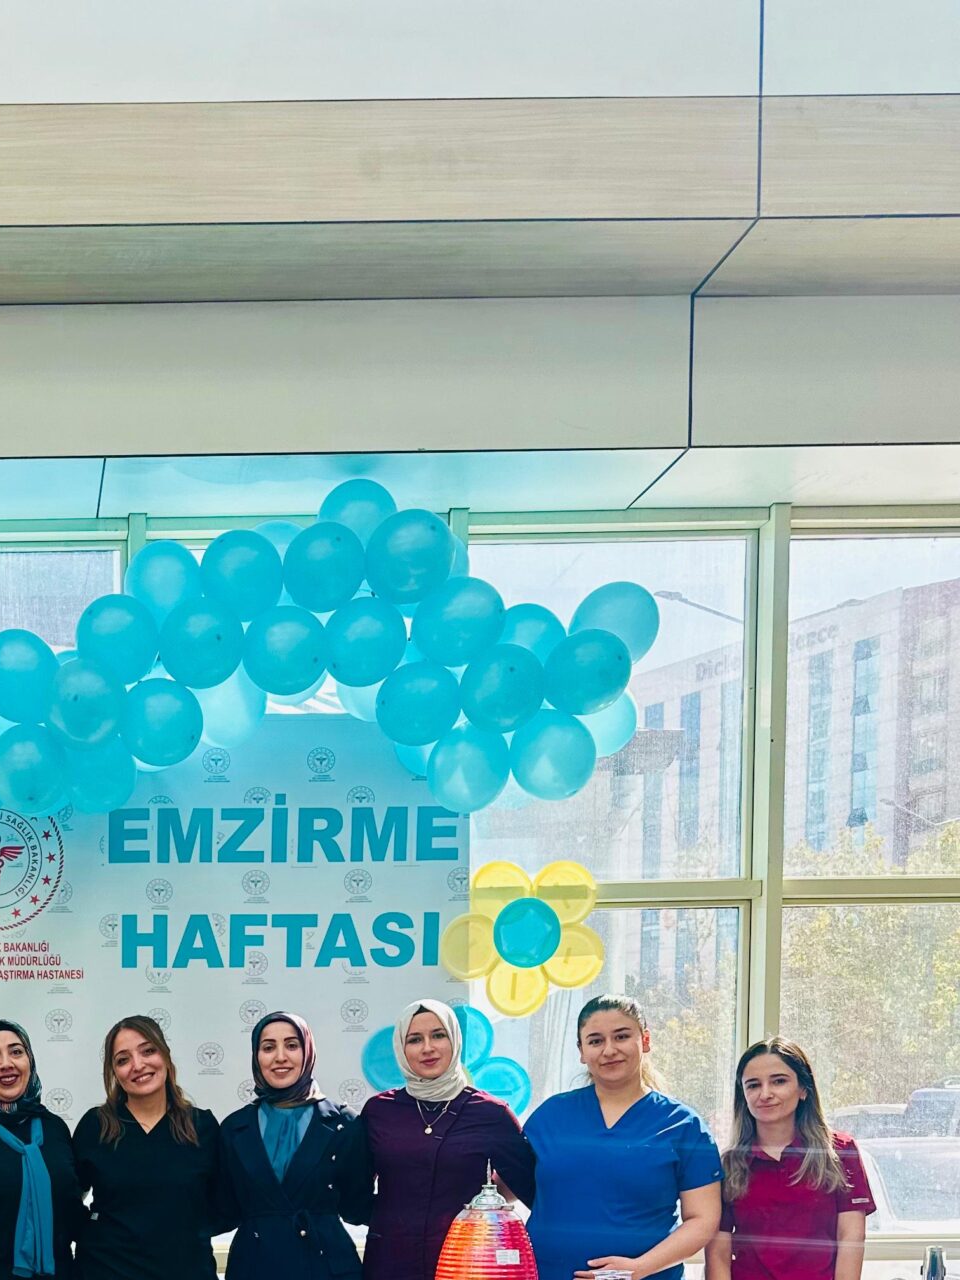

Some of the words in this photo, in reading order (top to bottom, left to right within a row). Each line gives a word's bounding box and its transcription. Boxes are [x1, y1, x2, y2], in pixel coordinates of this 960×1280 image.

[6, 815, 34, 842] SAĞLIK
[108, 793, 459, 864] EMZİRME
[15, 844, 38, 897] BAKANLIĞI
[4, 940, 49, 952] BAKANLIĞI
[121, 912, 439, 969] HAFTASI
[8, 954, 60, 965] MÜDÜRLÜĞÜ
[37, 968, 83, 979] HASTANESİ
